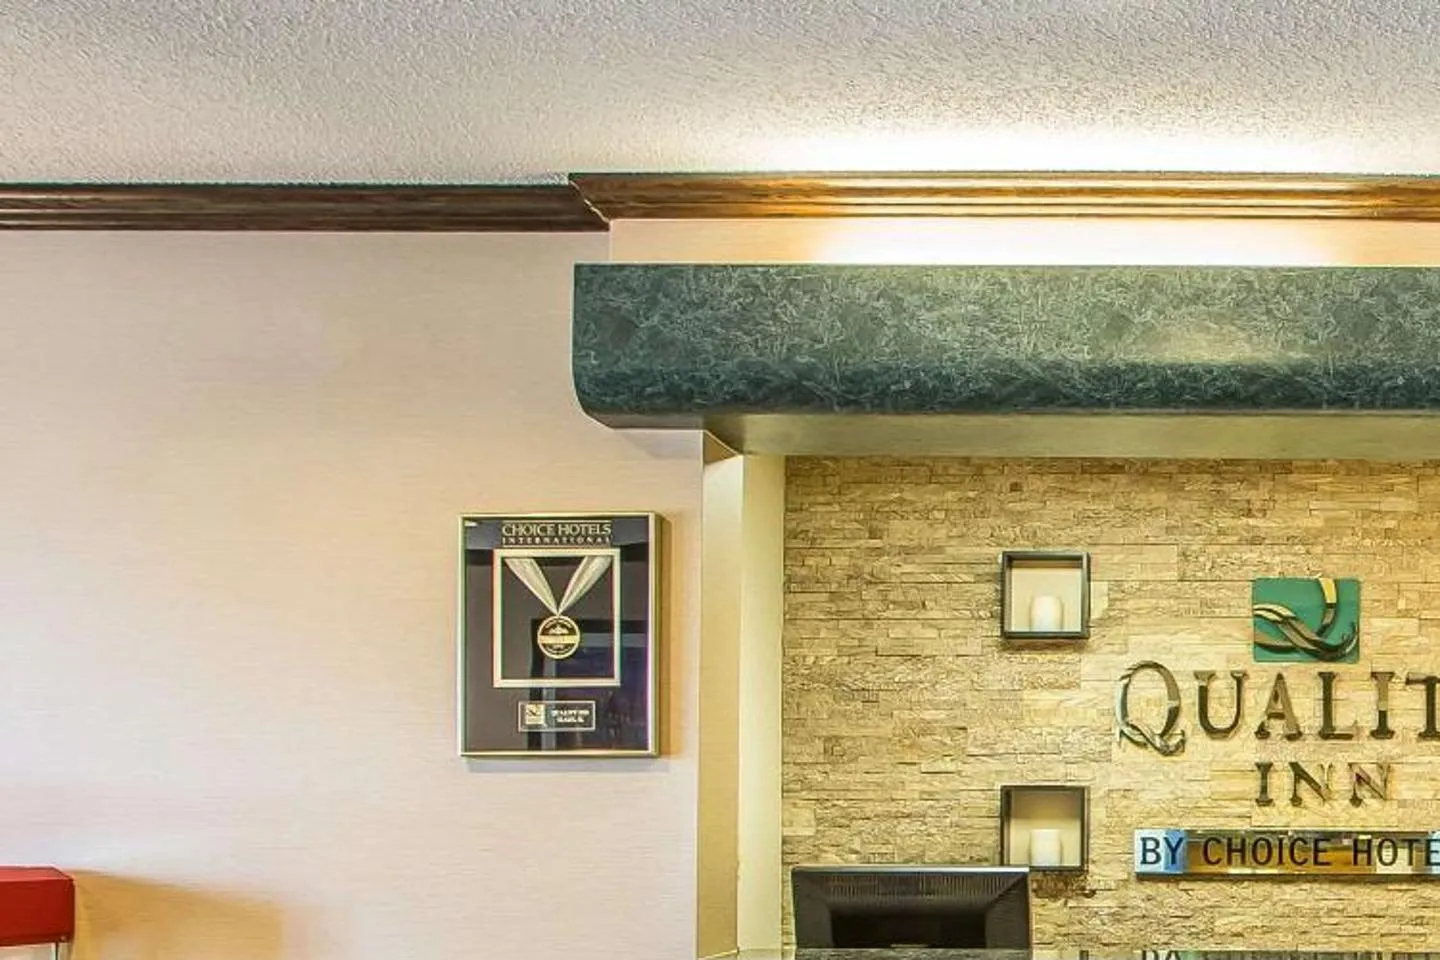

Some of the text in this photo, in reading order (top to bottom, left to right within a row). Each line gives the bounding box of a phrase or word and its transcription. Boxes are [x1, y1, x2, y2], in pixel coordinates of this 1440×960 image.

[502, 523, 612, 536] CHOICE HOTELS
[1254, 761, 1392, 808] INN
[1140, 836, 1184, 866] BY
[1202, 836, 1332, 867] CHOICE
